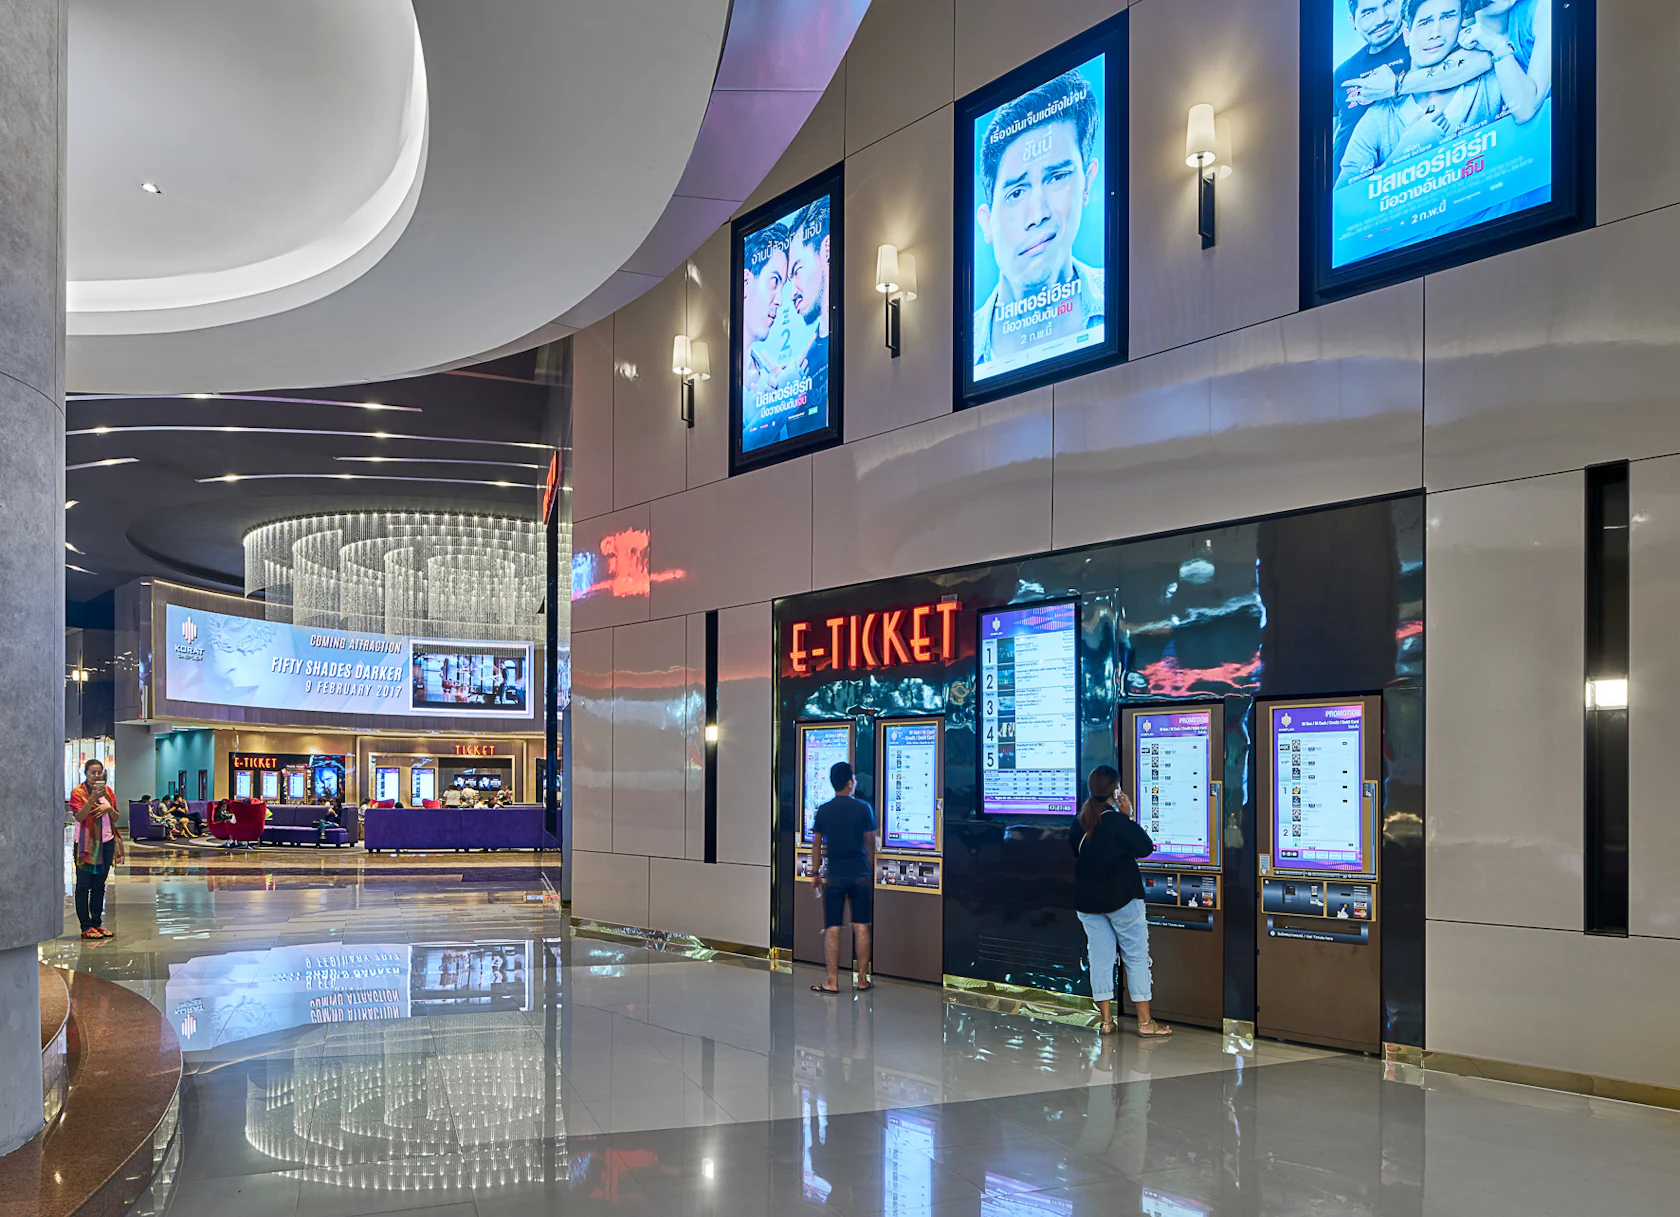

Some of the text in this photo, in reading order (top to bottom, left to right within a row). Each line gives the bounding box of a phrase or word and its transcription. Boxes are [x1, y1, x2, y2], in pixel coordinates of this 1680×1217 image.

[1022, 123, 1053, 162] ซันนี่
[1368, 129, 1497, 200] มิสเตอร์เฮิร์ท
[1379, 154, 1485, 212] มือวางอันดับเจ็บ
[995, 276, 1082, 322] มิสเตอร์เฮิร์ท
[1002, 296, 1074, 335] มือวางอันดับเจ็บ
[780, 328, 792, 352] 2
[1020, 334, 1027, 345] 2
[310, 634, 402, 654] COMING ATTRACTION
[790, 601, 962, 672] E-TICKET
[174, 644, 205, 656] KORAT
[986, 648, 992, 664] 1
[271, 657, 403, 682] FIFTY SHADES DARKER
[305, 680, 402, 698] 9 FEBRUARY 2017
[986, 674, 994, 690] 2
[986, 700, 994, 715] 3
[1325, 709, 1361, 718] PROMOTION
[986, 726, 994, 741] 4
[455, 744, 495, 756] TICKET
[234, 757, 277, 769] E-TICKET
[987, 752, 994, 767] 5
